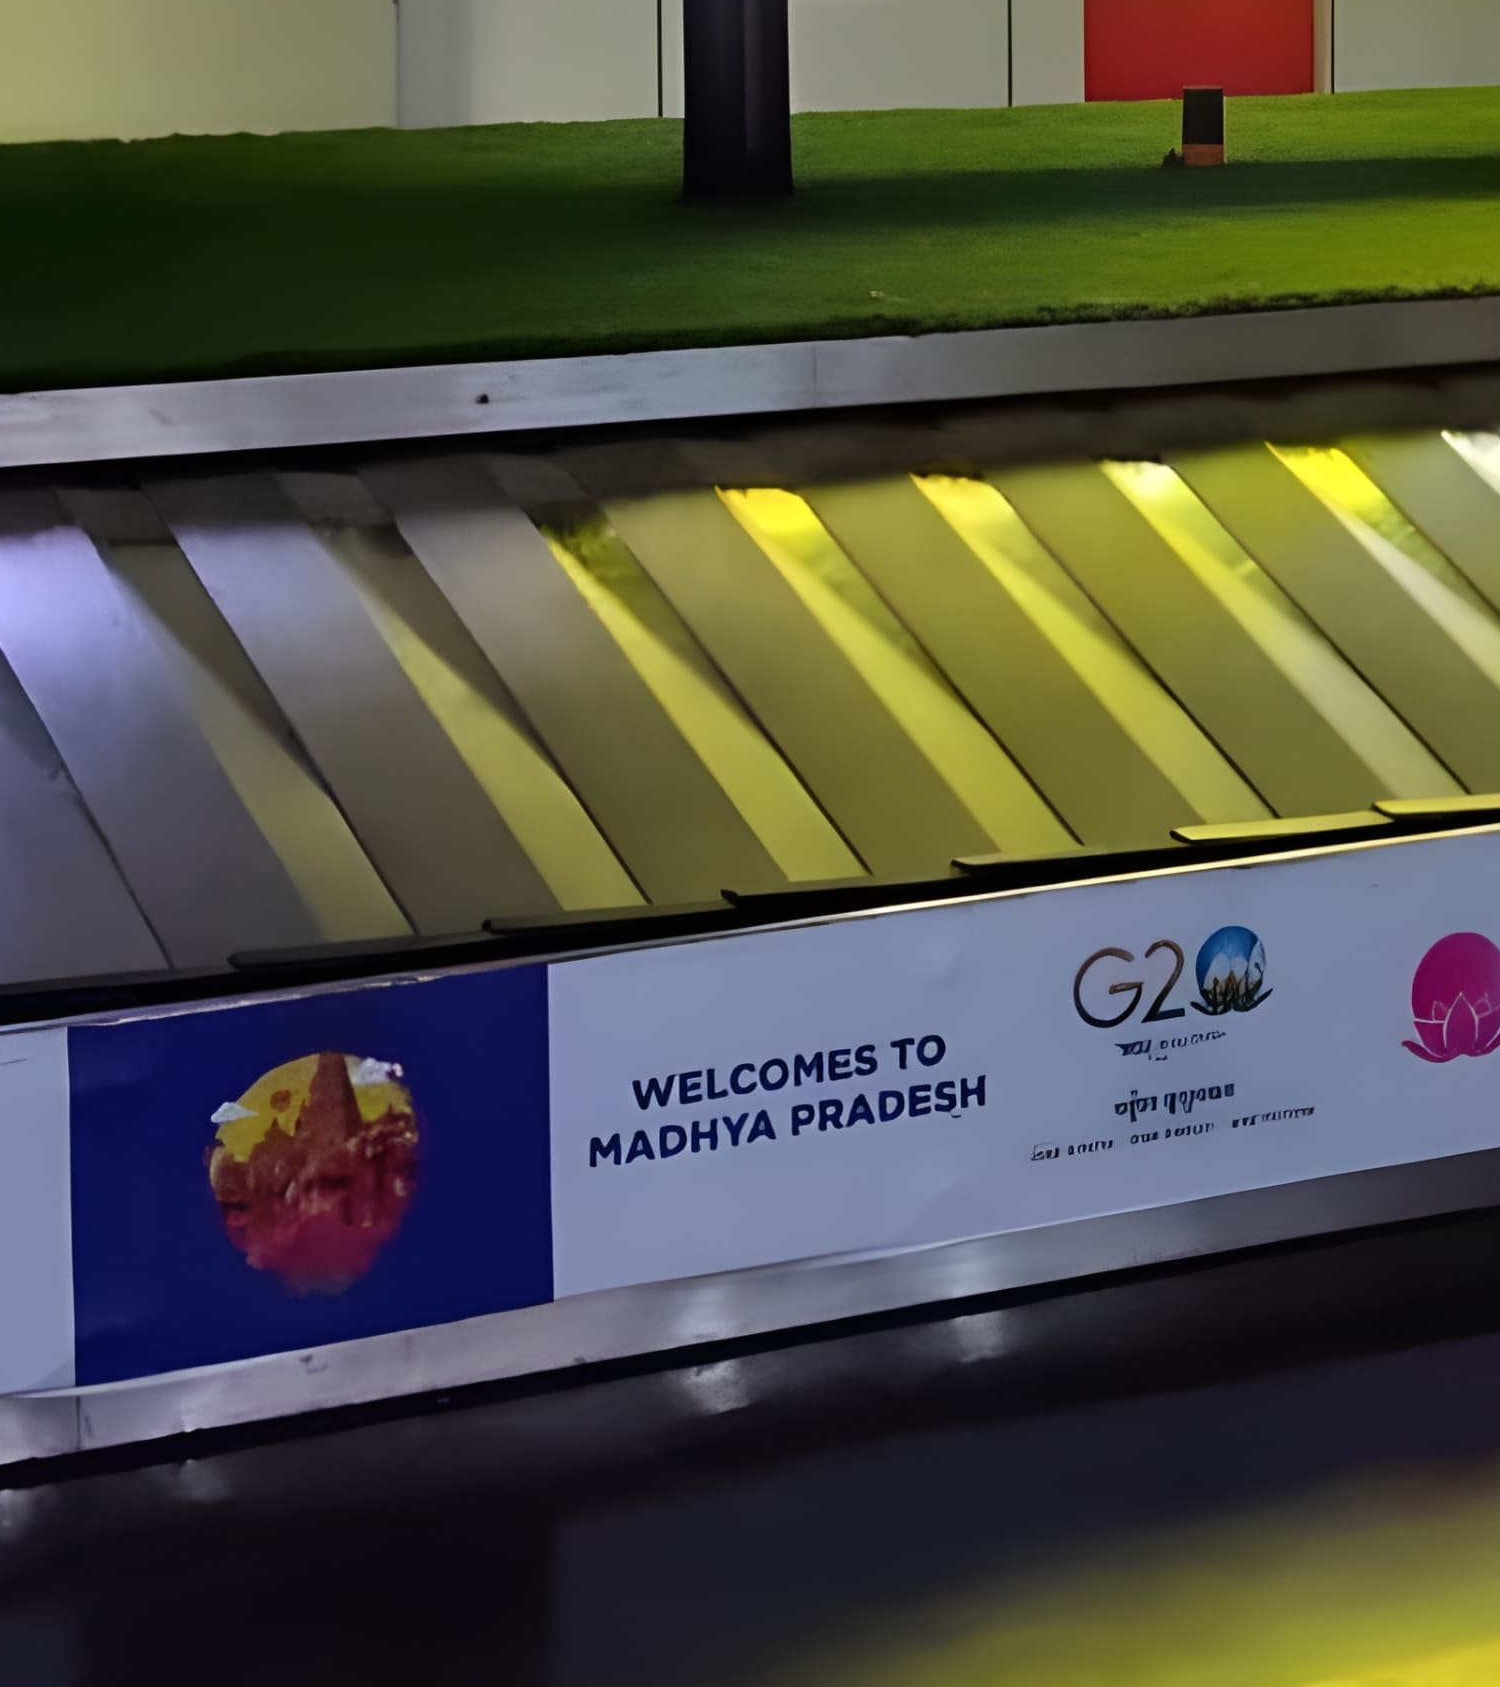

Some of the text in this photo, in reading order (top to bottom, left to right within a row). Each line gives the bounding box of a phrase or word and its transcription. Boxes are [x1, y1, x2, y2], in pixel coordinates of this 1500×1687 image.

[632, 1034, 947, 1111] WELCOMES TO
[589, 1109, 777, 1168] MADHYA
[790, 1075, 987, 1137] PRADESH
